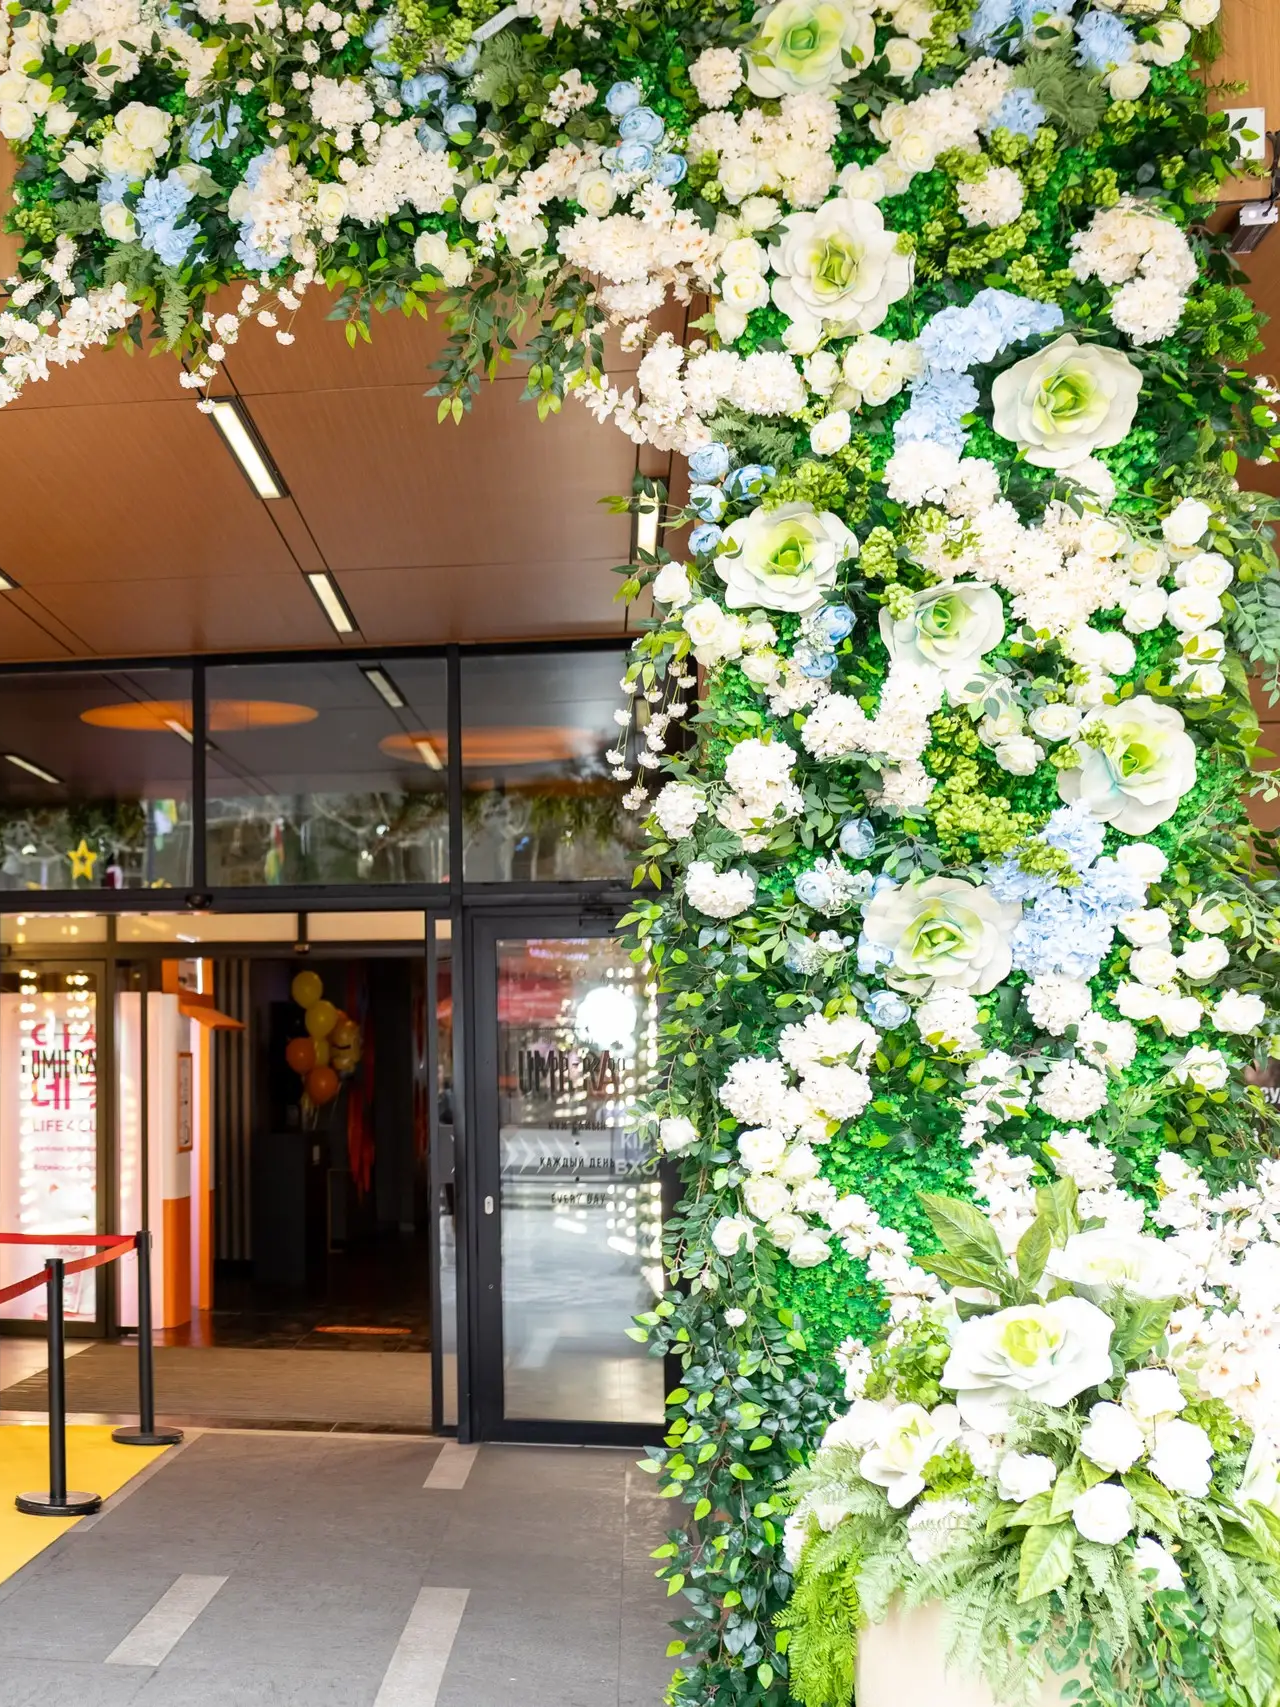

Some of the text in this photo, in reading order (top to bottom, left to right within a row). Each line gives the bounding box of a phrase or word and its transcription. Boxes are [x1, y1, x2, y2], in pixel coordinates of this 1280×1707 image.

[32, 1119, 64, 1132] LIFE
[539, 1156, 616, 1169] КАЖДЫЙ ДЕНЬ
[615, 1158, 661, 1179] ВХО
